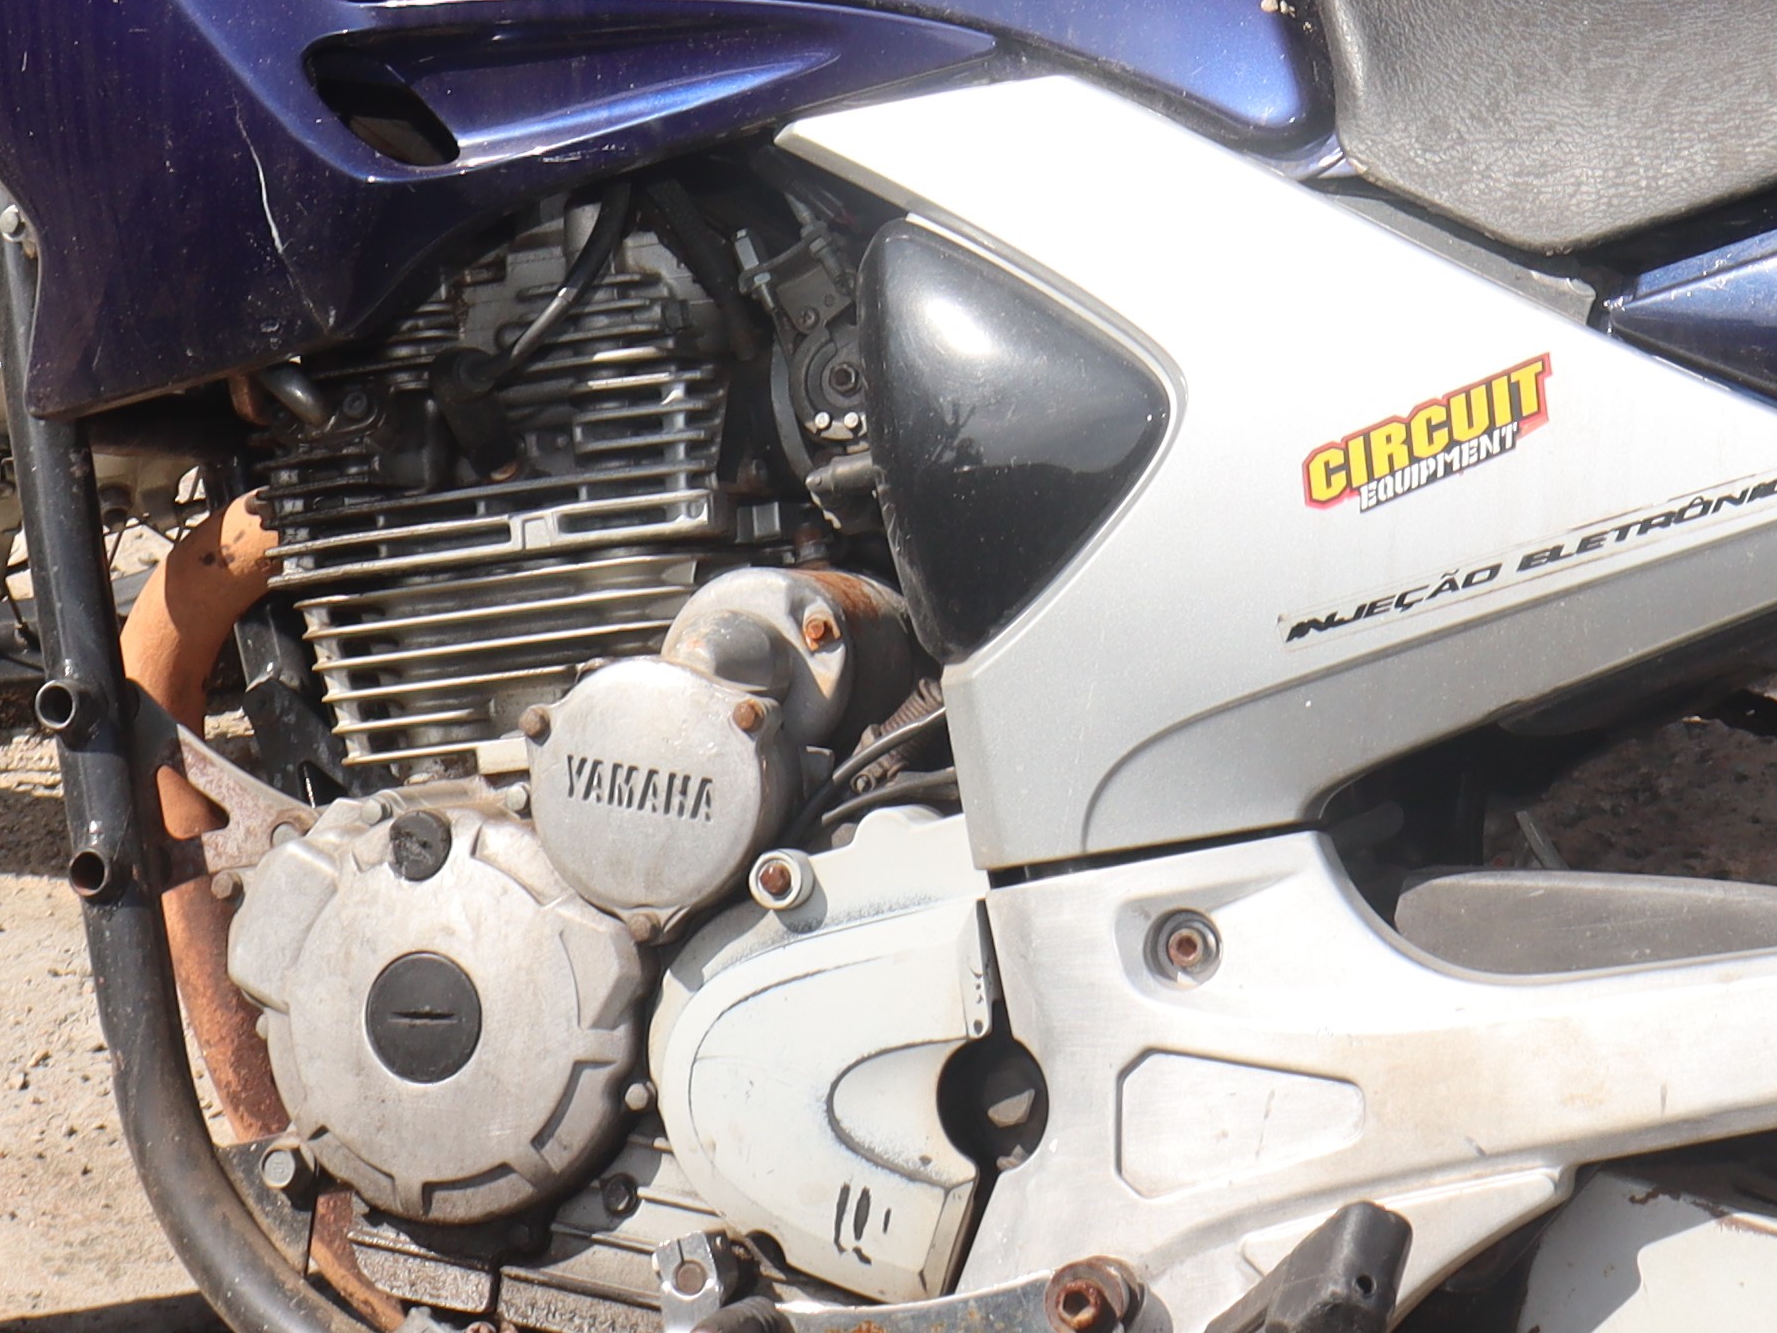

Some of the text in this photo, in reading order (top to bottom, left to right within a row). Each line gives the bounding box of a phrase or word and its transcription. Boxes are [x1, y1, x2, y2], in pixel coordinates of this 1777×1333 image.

[1308, 359, 1545, 504] CIRCUIT
[1358, 420, 1520, 513] EQUIPMENT
[1284, 563, 1503, 644] INJEÇÃO
[565, 753, 716, 825] YAMAHA
